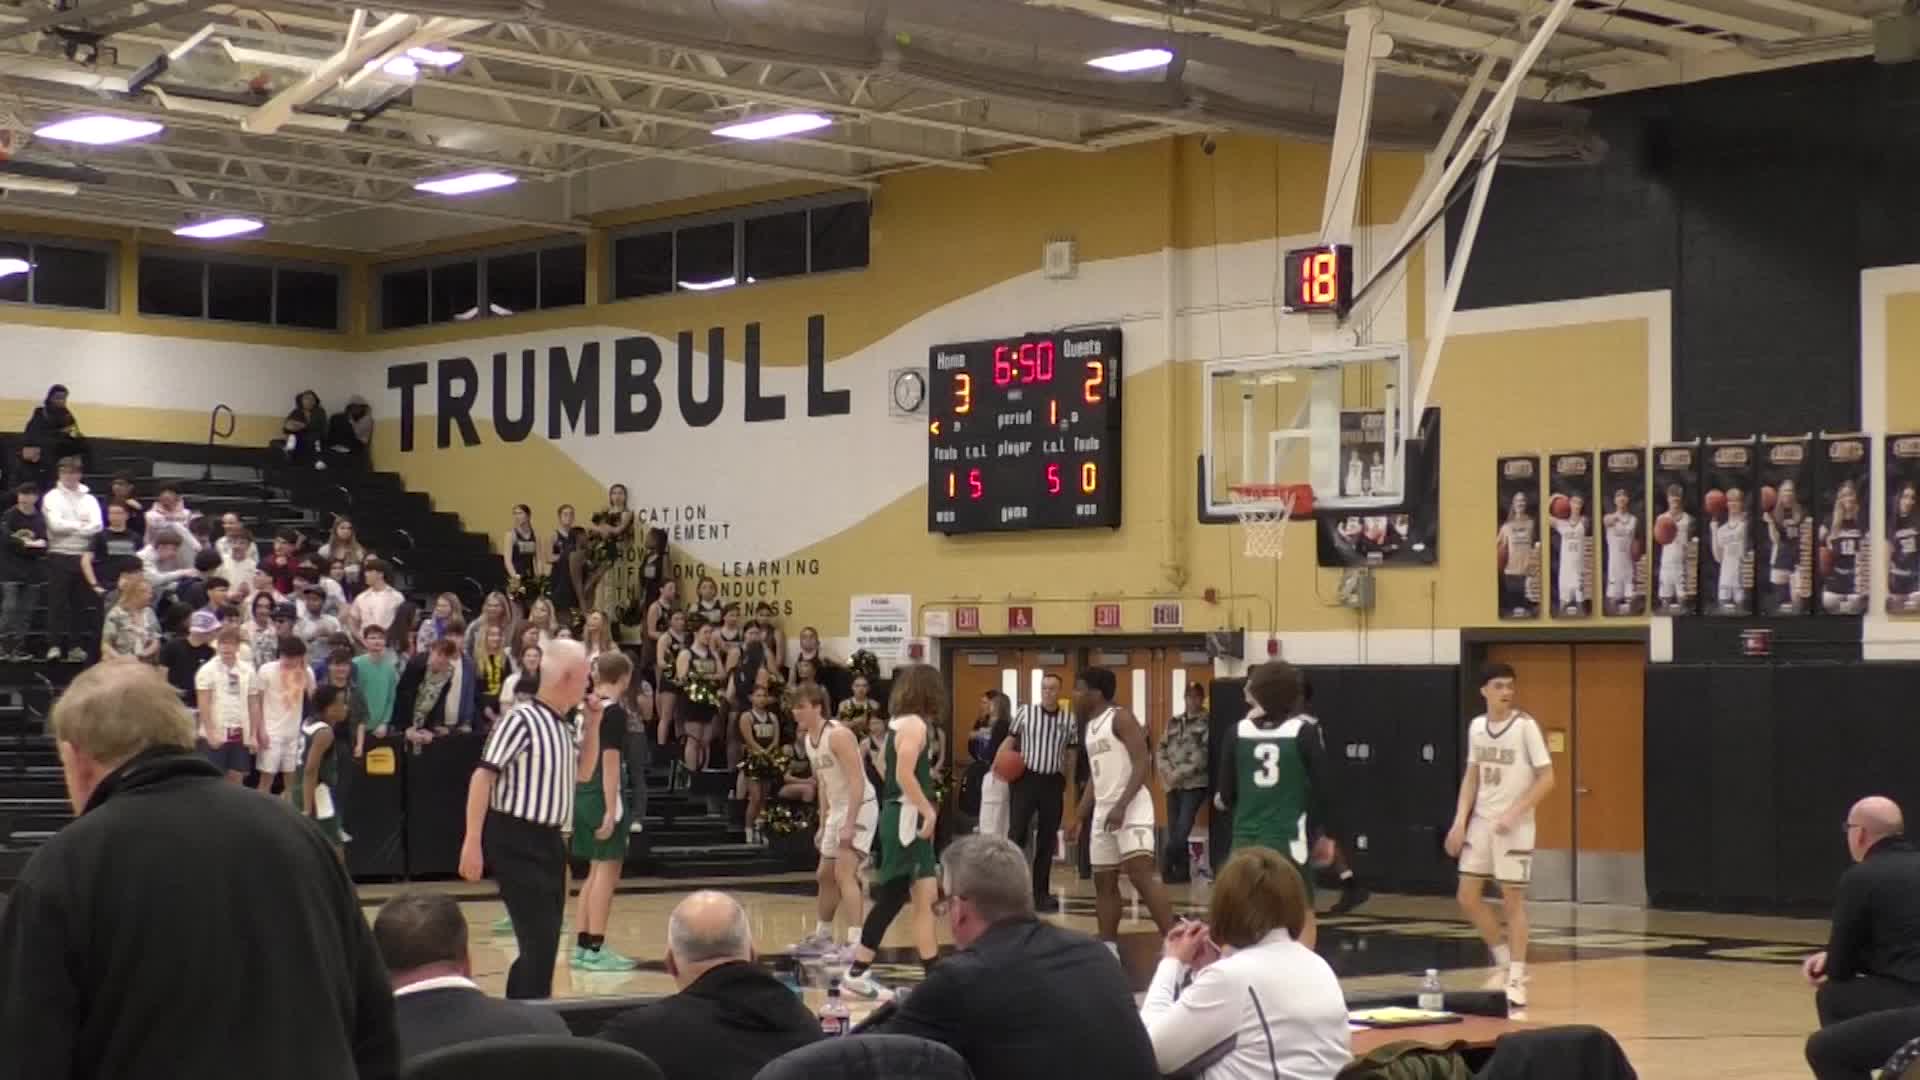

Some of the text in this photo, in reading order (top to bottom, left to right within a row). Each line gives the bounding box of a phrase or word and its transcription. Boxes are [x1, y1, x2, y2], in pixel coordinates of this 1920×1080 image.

[1302, 253, 1336, 303] 18
[937, 352, 966, 370] Home
[994, 341, 1056, 385] 6:50
[1063, 339, 1101, 358] Guests
[387, 315, 850, 452] TRUMBULL
[953, 372, 971, 414] 3
[1085, 361, 1103, 402] 2
[998, 409, 1032, 430] period
[1050, 399, 1057, 425] 1
[949, 472, 955, 497] 1
[969, 470, 982, 498] 5
[1047, 464, 1061, 493] 5
[1082, 462, 1097, 492] 0
[721, 559, 820, 578] LEARNING
[1253, 743, 1280, 787] 3
